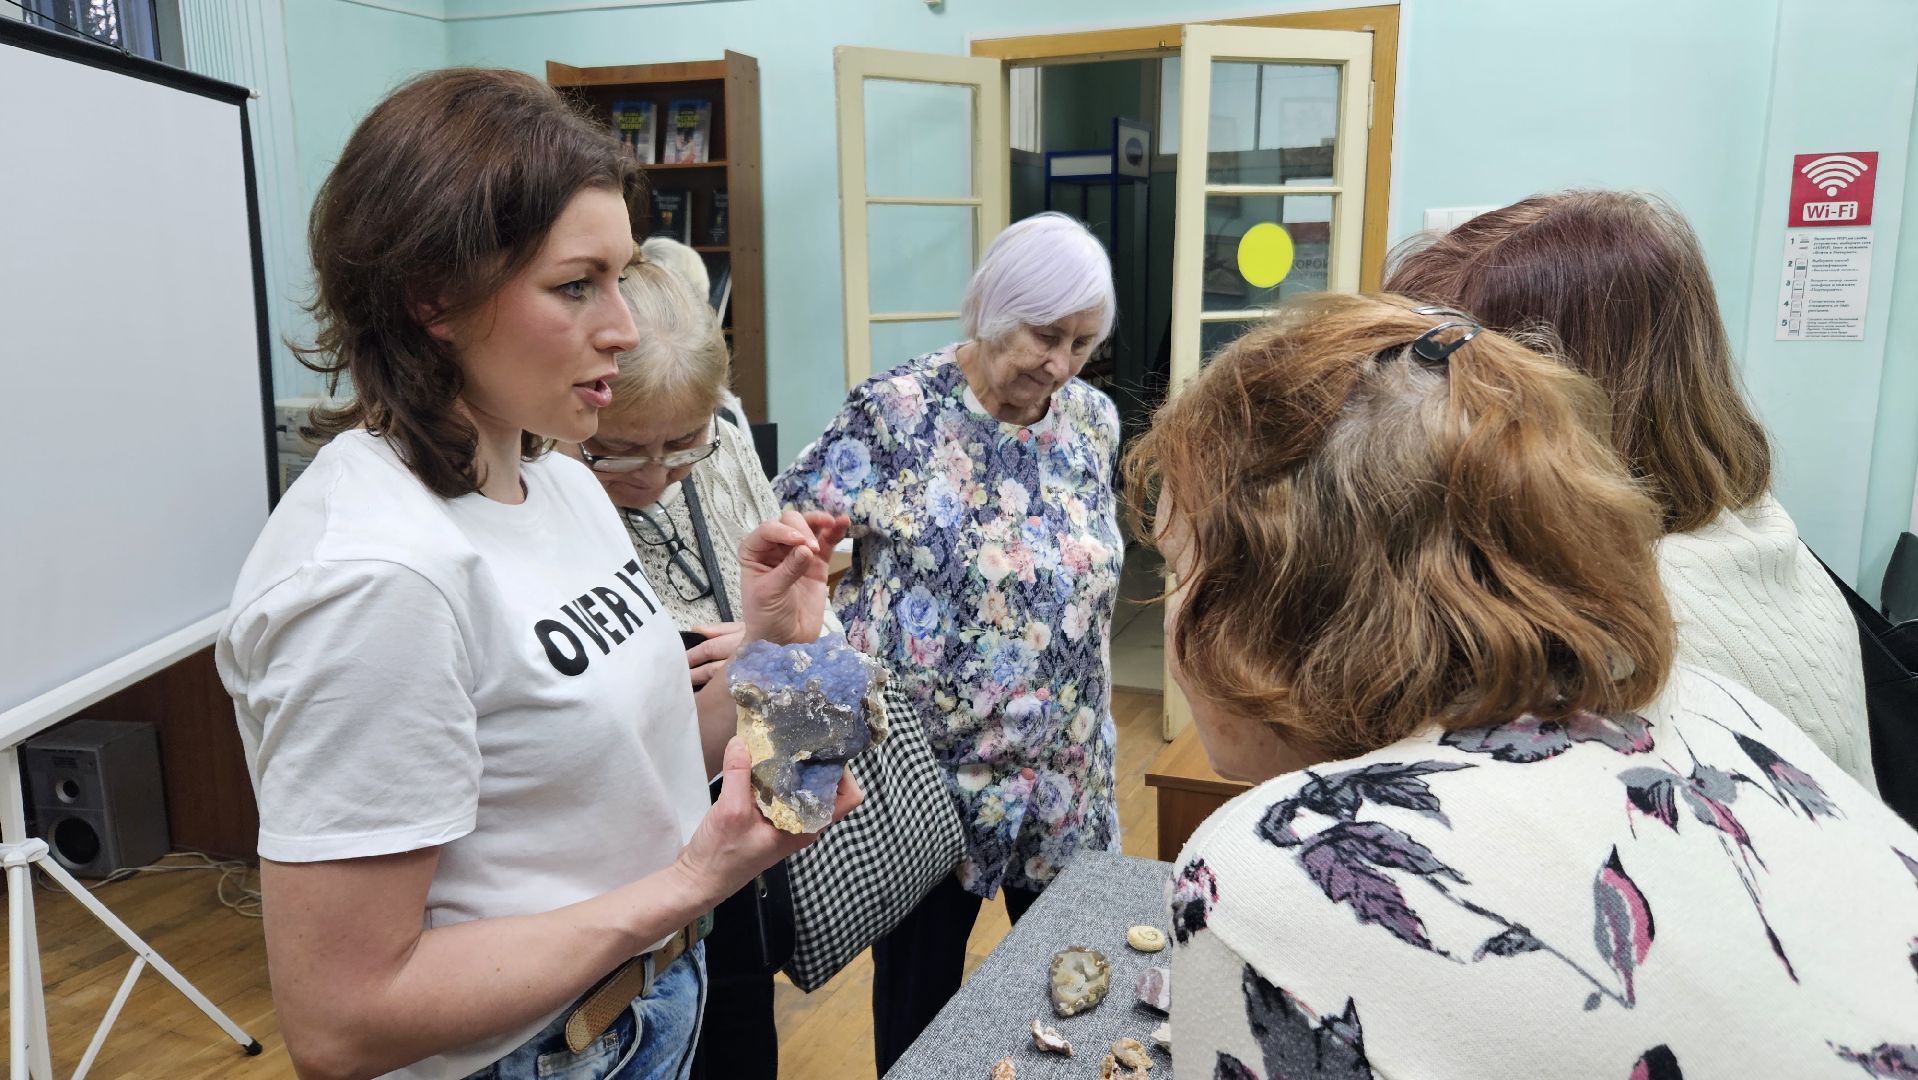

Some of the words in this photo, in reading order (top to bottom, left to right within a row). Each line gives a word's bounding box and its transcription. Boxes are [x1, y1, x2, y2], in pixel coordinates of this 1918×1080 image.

[1806, 203, 1855, 219] Wi-Fi
[1790, 237, 1795, 245] 1
[1785, 279, 1791, 287] 3
[1781, 319, 1788, 327] 5
[534, 586, 644, 677] OVER
